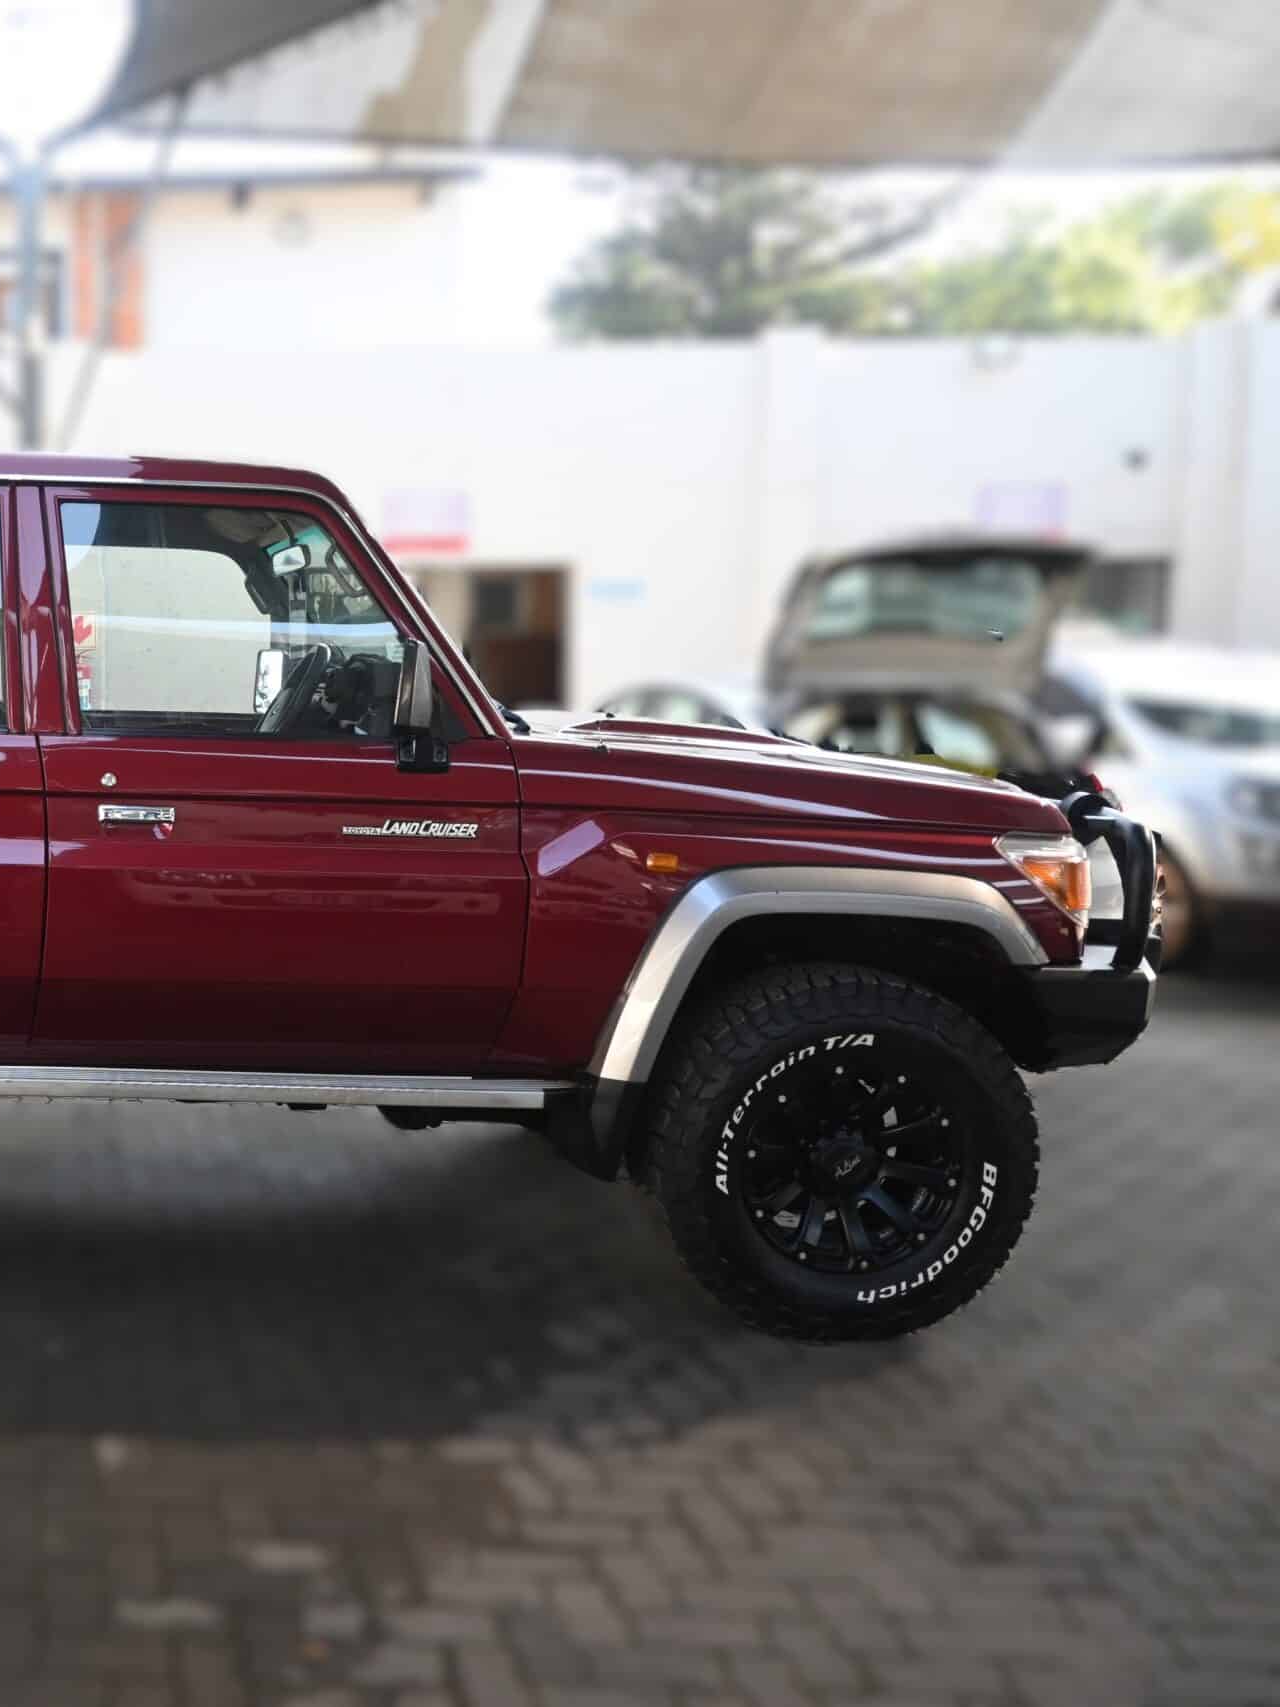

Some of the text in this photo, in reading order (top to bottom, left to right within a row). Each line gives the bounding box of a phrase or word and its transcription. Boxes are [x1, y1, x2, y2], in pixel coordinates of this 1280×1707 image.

[381, 819, 420, 836] LAND
[419, 820, 479, 838] CRUISER
[715, 1033, 875, 1195] All-Terrain T/A
[856, 1161, 998, 1304] BFGoodrich
